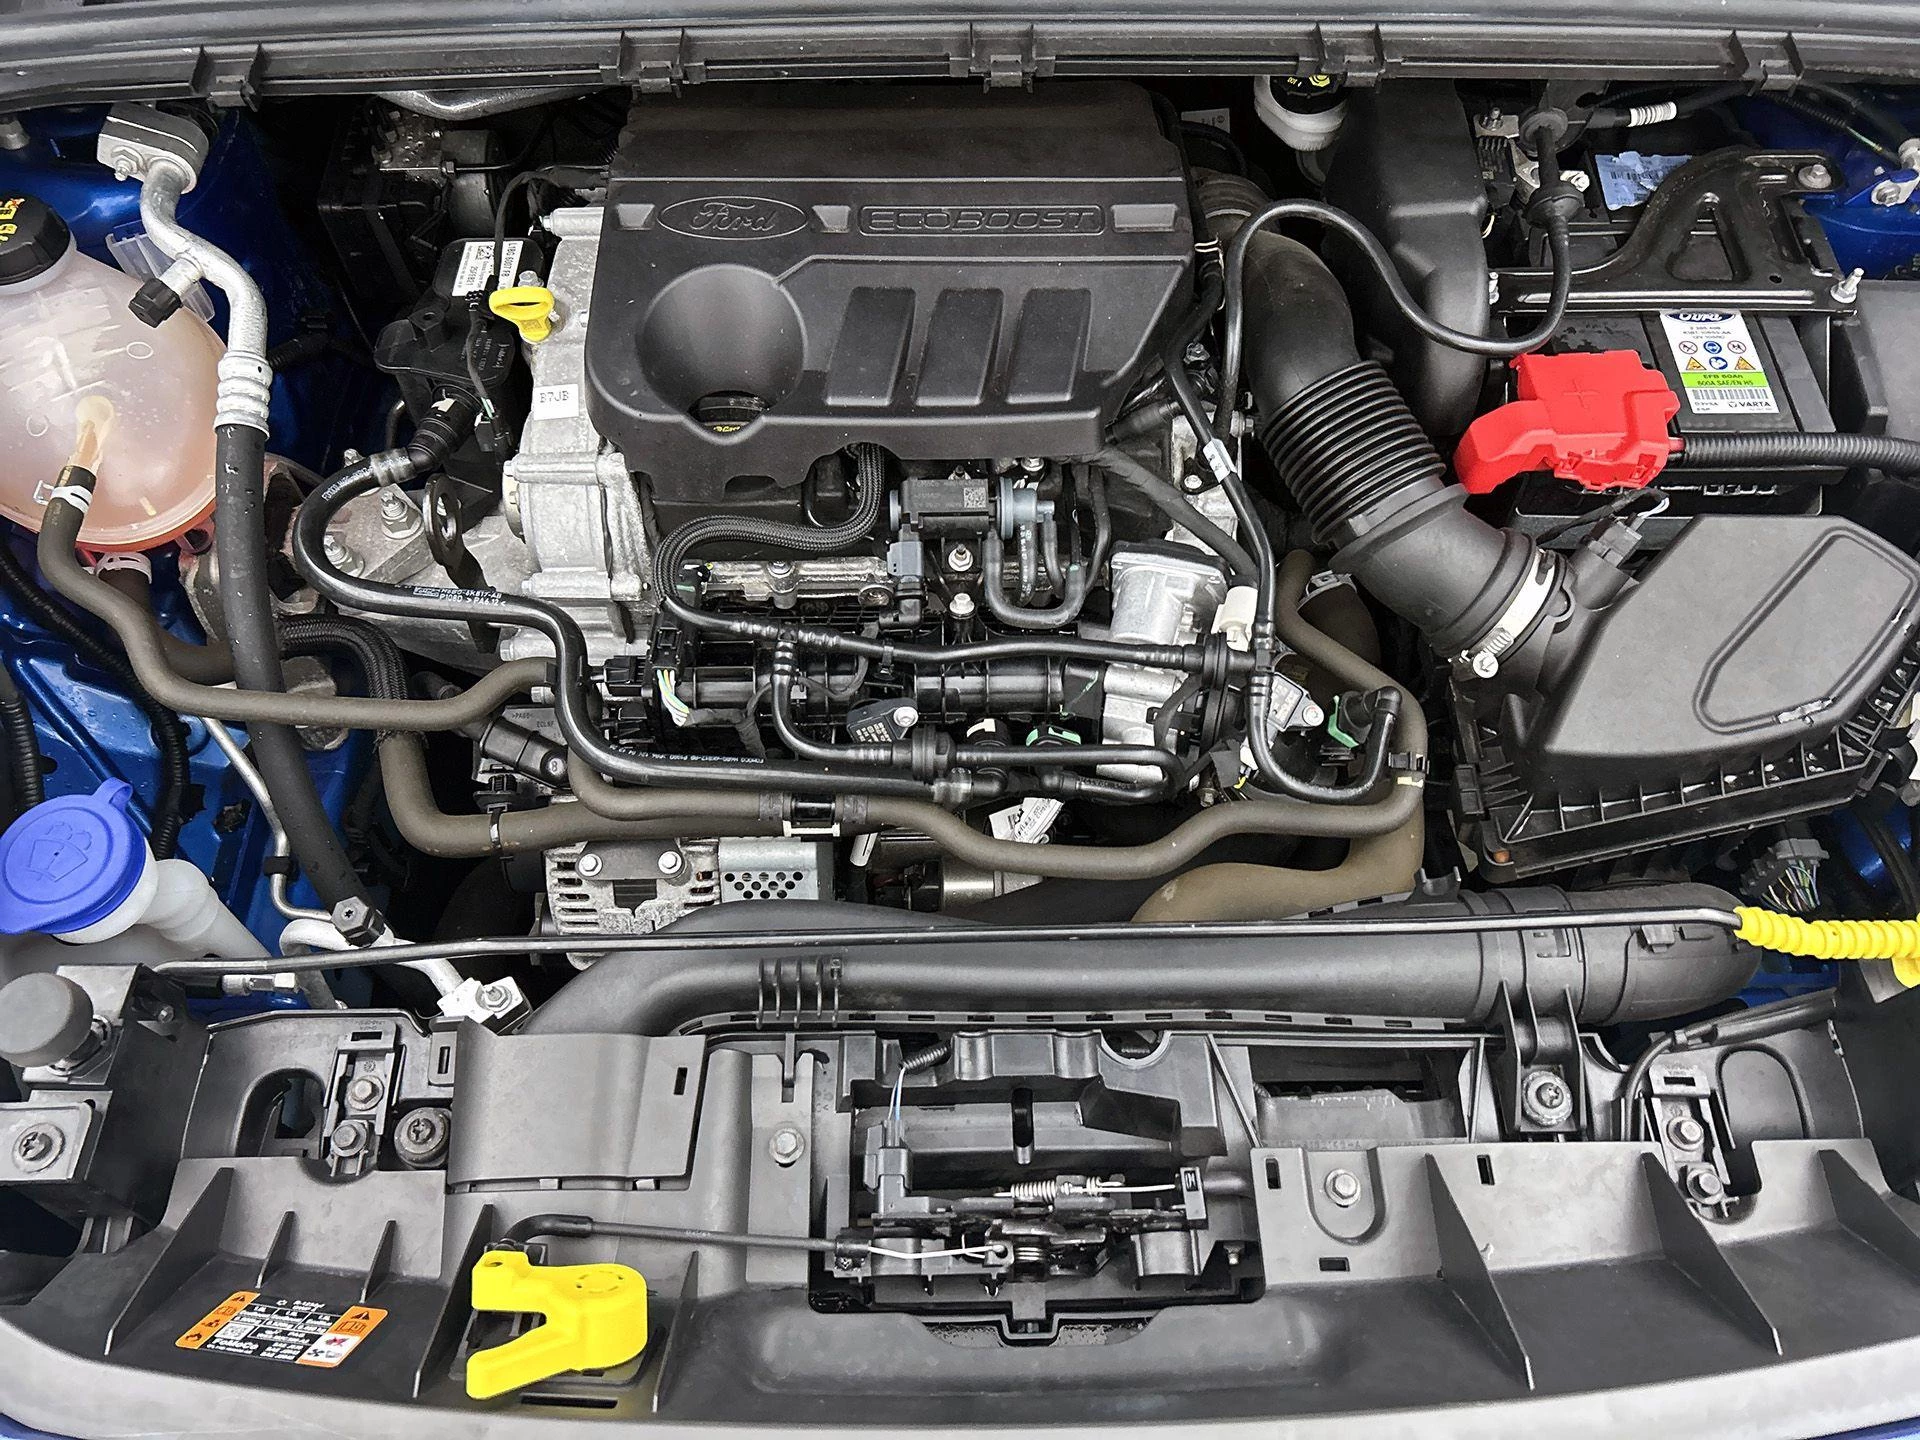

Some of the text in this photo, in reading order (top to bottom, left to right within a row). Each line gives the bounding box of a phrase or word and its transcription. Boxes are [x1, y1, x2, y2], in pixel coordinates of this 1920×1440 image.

[689, 202, 1094, 232] Ford ECOBOOST
[540, 390, 569, 403] B7JB
